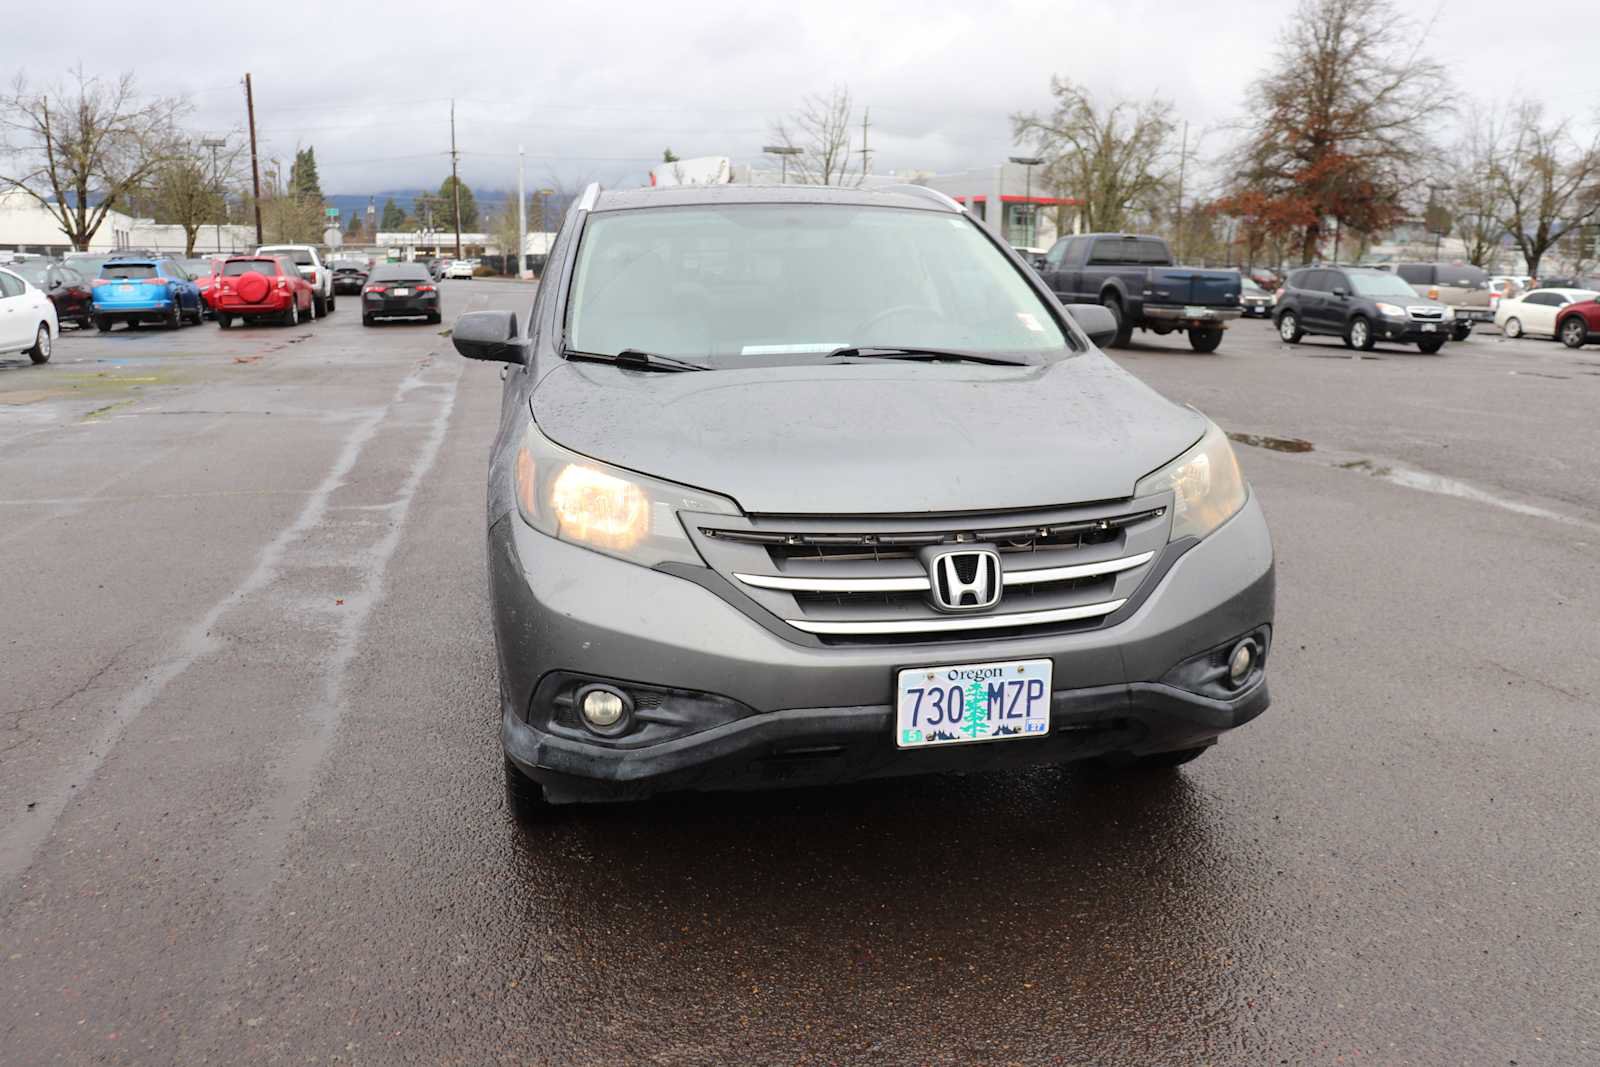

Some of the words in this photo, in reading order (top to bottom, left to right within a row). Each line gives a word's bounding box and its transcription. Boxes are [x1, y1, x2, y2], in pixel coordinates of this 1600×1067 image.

[947, 667, 1003, 682] Oregon
[906, 685, 964, 728] 730
[986, 679, 1044, 721] MZP
